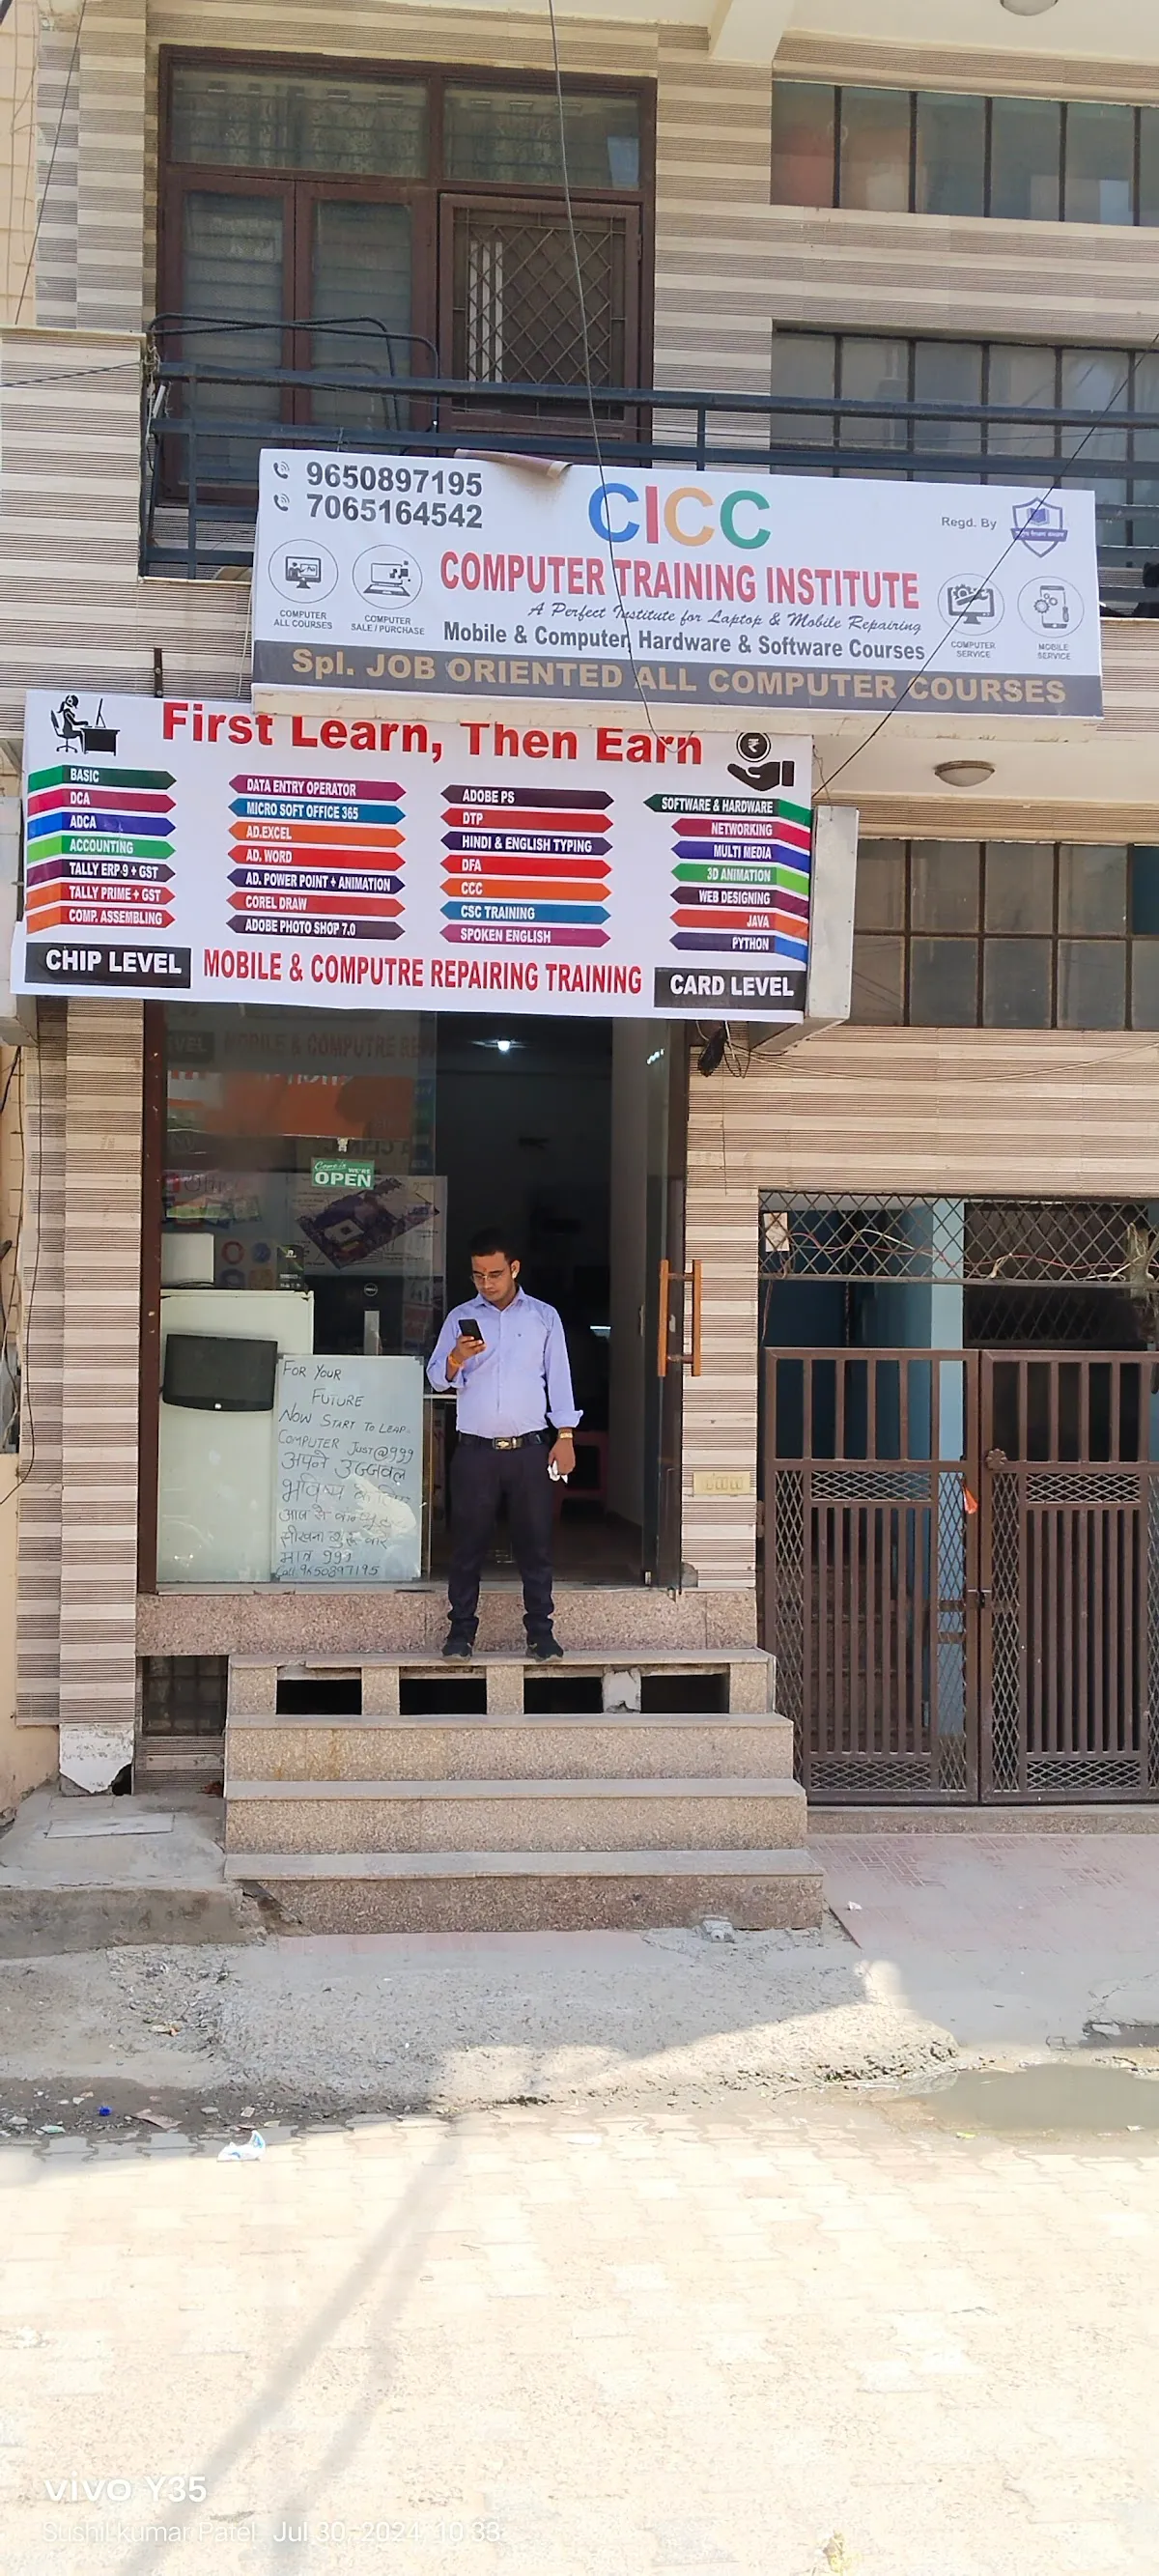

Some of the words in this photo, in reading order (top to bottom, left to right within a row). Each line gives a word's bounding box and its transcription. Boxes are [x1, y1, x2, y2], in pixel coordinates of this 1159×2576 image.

[306, 461, 483, 496] 9650897195
[306, 493, 483, 529] 7065164542
[588, 482, 771, 550] CICC
[942, 516, 977, 528] Regd.
[981, 518, 997, 530] By
[440, 551, 605, 595] COMPUTER
[615, 560, 757, 604] TRAINING
[767, 567, 919, 609] INSTITUTE
[279, 609, 326, 620] COMPUTER
[365, 614, 411, 625] COMPUTER
[527, 602, 544, 617] A
[551, 602, 607, 620] Perfect
[612, 605, 675, 623] Institute
[679, 610, 702, 626] for
[708, 609, 762, 628] Laptop
[769, 612, 781, 626] &
[787, 612, 841, 630] Mobile
[848, 616, 921, 635] Repairing
[273, 618, 290, 628] ALL
[292, 619, 333, 630] COURSES
[351, 623, 373, 633] SALE
[380, 625, 425, 636] PURCHASE
[444, 621, 507, 643] Mobile
[514, 626, 527, 643] &
[637, 632, 731, 654] Hardware
[738, 635, 751, 654] &
[758, 636, 843, 657] Software
[849, 639, 925, 661] Courses
[950, 640, 996, 650] COMPUTER
[1038, 643, 1069, 652] MOBILE
[956, 650, 991, 659] SERVICE
[1037, 652, 1071, 661] SERVICE
[292, 648, 354, 680] Spl.
[366, 653, 437, 680] JOB
[447, 658, 623, 689] ORIENTED
[633, 666, 697, 693] ALL
[709, 668, 897, 699] COMPUTER
[908, 676, 1066, 704] COURSES
[162, 701, 273, 746] First
[292, 716, 443, 763] Learn,
[460, 722, 578, 761] Then
[596, 727, 702, 765] Earn
[70, 769, 99, 782] BASIC
[247, 779, 271, 793] DATA
[273, 781, 305, 795] ENTRY
[306, 782, 356, 797] OPERATOR
[70, 792, 91, 806] DCA
[463, 790, 498, 804] ADOBE
[500, 791, 515, 805] PS
[246, 803, 277, 816] MICRO
[279, 805, 304, 818] SOFT
[306, 806, 340, 819] OFFICE
[341, 807, 358, 820] 365
[662, 798, 711, 811] SOFTWARE
[712, 799, 721, 812] &
[722, 799, 774, 813] HARDWARE
[70, 815, 97, 829] ADCA
[463, 812, 484, 826] DTP
[711, 822, 773, 836] NETWORKING
[69, 839, 133, 855] ACCOUNTING
[462, 835, 492, 849] HINDI
[495, 836, 503, 850] &
[505, 837, 551, 852] ENGLISH
[553, 839, 592, 853] TYPING
[246, 849, 262, 863] AD.
[265, 850, 293, 863] WORD
[714, 845, 741, 859] MULTI
[743, 846, 772, 860] MEDIA
[70, 863, 99, 876] TALLY
[130, 867, 137, 876] +
[139, 865, 159, 880] GST
[462, 859, 482, 872] DFA
[246, 873, 262, 886] AD.
[263, 874, 297, 888] POWER
[298, 875, 328, 889] POINT
[330, 877, 336, 888] +
[337, 877, 391, 892] ANIMATION
[707, 867, 720, 881] 3D
[721, 868, 771, 883] ANIMATION
[69, 887, 99, 900] TALLY
[100, 888, 131, 901] PRIME
[132, 892, 140, 900] +
[141, 890, 161, 903] GST
[461, 882, 483, 895] CCC
[245, 895, 275, 910] COREL
[277, 897, 307, 911] DRAW
[698, 891, 720, 904] WEB
[721, 892, 771, 905] DESIGNING
[69, 910, 99, 923] COMP.
[99, 911, 162, 925] ASSEMBLING
[461, 906, 482, 919] CSC
[484, 907, 536, 920] TRAINING
[245, 920, 278, 933] ADOBE
[279, 920, 312, 935] PHOTO
[313, 921, 340, 936] SHOP
[341, 922, 355, 936] 7.0
[747, 914, 770, 928] JAVA
[461, 929, 503, 943] SPOKEN
[505, 930, 551, 944] ENGLISH
[732, 936, 770, 950] PYTHON
[45, 949, 101, 972] CHIP
[109, 951, 182, 976] LEVEL
[204, 948, 282, 979] MOBILE
[290, 953, 303, 982] &
[311, 954, 423, 986] COMPUTRE
[431, 961, 538, 992] REPAIRING
[547, 963, 641, 994] TRAINING
[670, 975, 724, 996] CARD
[731, 977, 794, 998] LEVEL
[314, 1171, 372, 1188] OPEN
[283, 1359, 306, 1377] FOR
[314, 1364, 342, 1381] YOUR
[311, 1387, 365, 1407] FUTURE
[278, 1402, 313, 1425] NOW
[320, 1413, 356, 1430] START
[278, 1429, 340, 1449] COMPUTER
